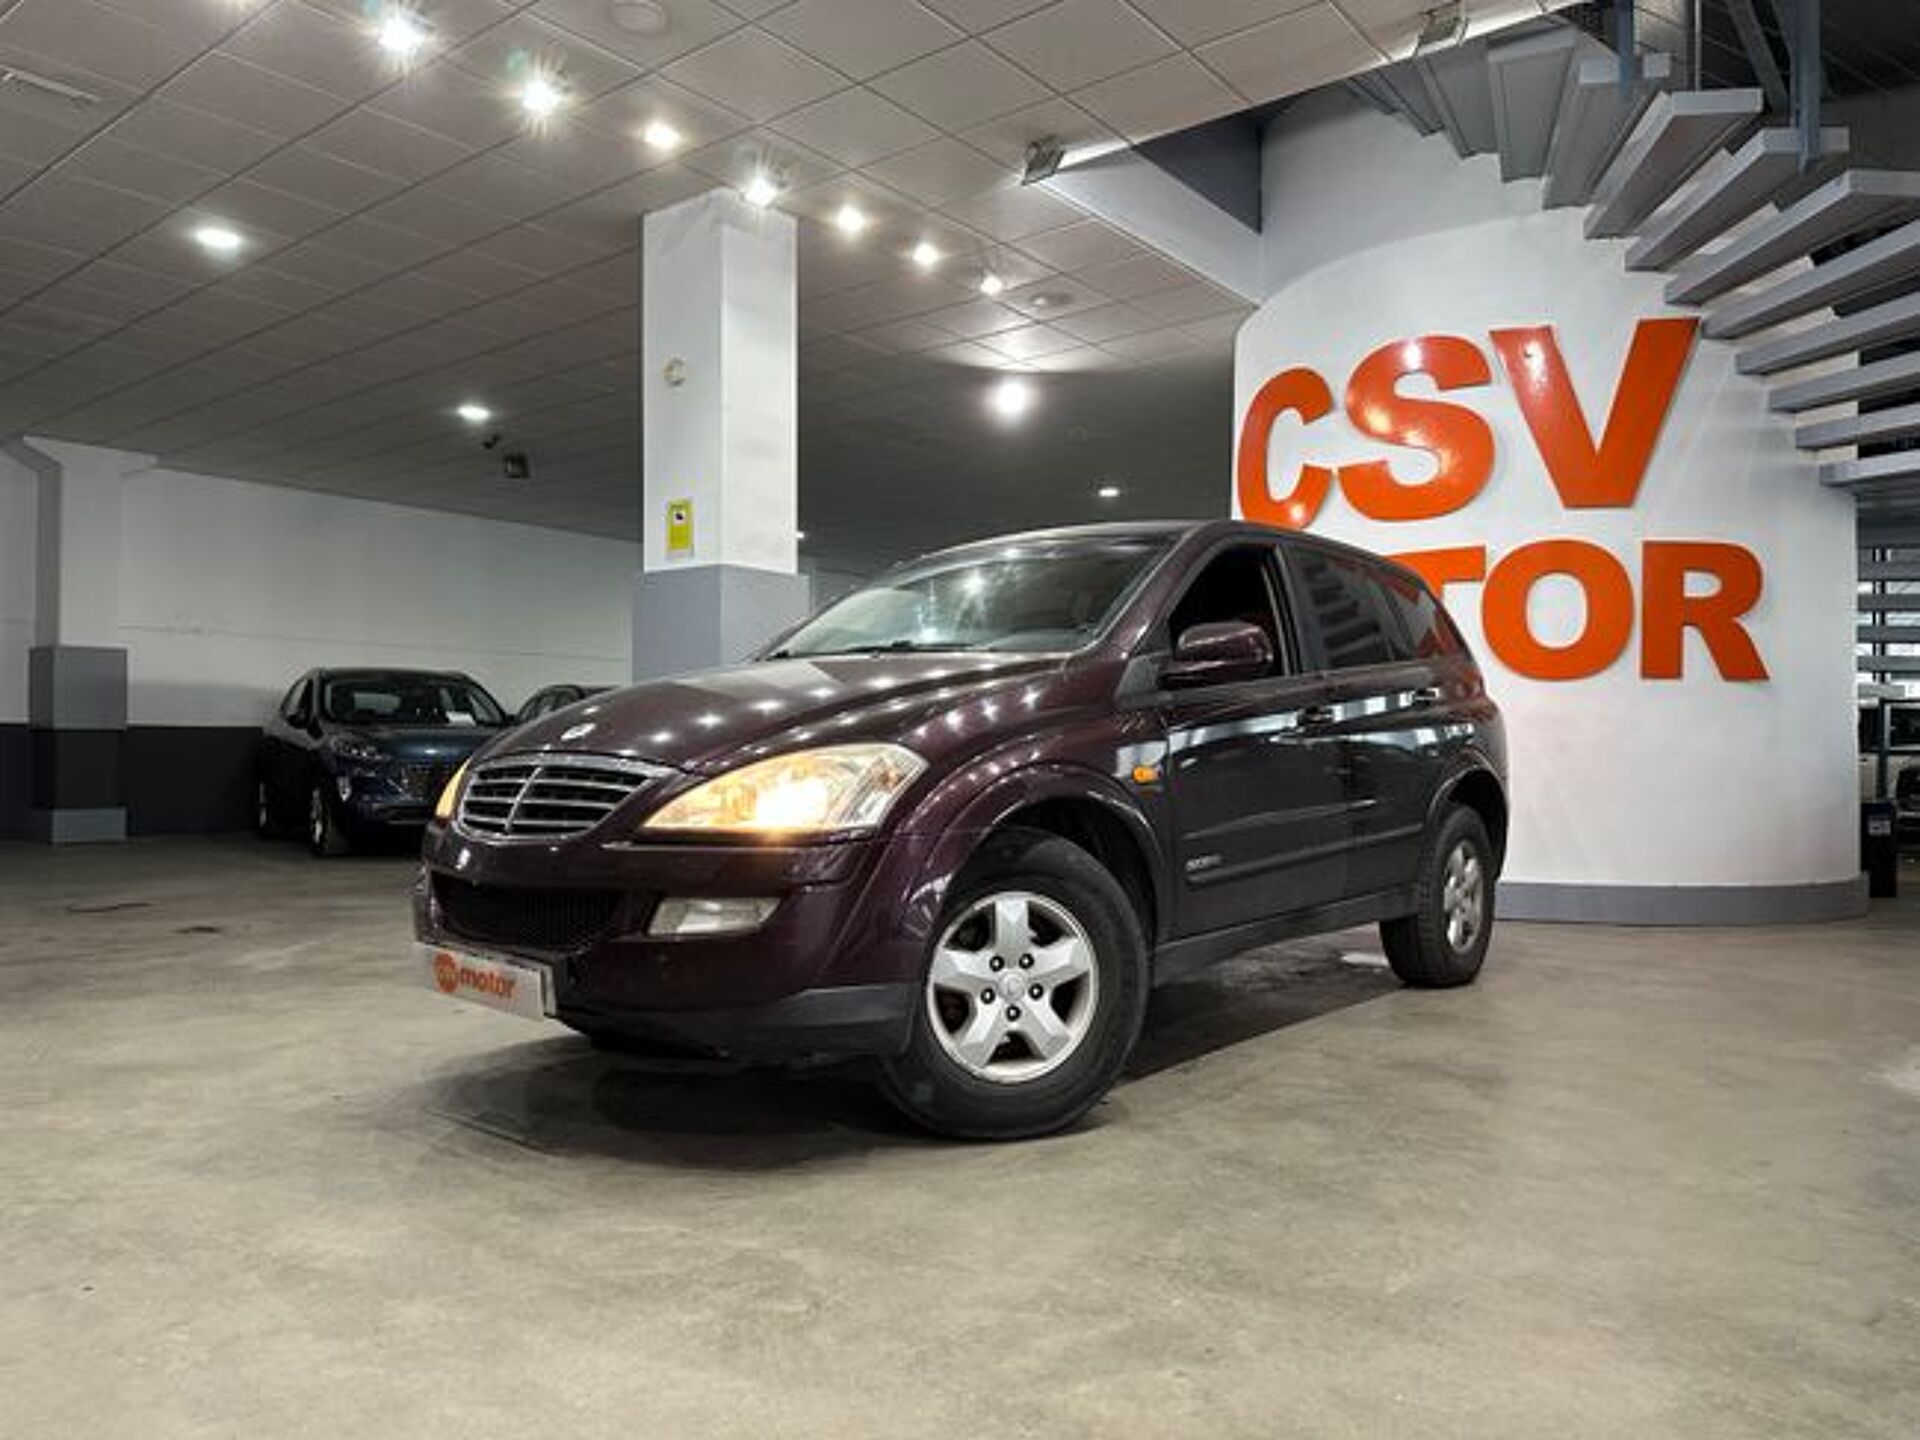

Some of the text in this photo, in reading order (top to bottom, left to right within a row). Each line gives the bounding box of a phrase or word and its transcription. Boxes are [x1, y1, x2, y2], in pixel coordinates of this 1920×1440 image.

[1238, 317, 1700, 529] CSV
[1386, 539, 1770, 681] TOR
[461, 967, 516, 998] motor
